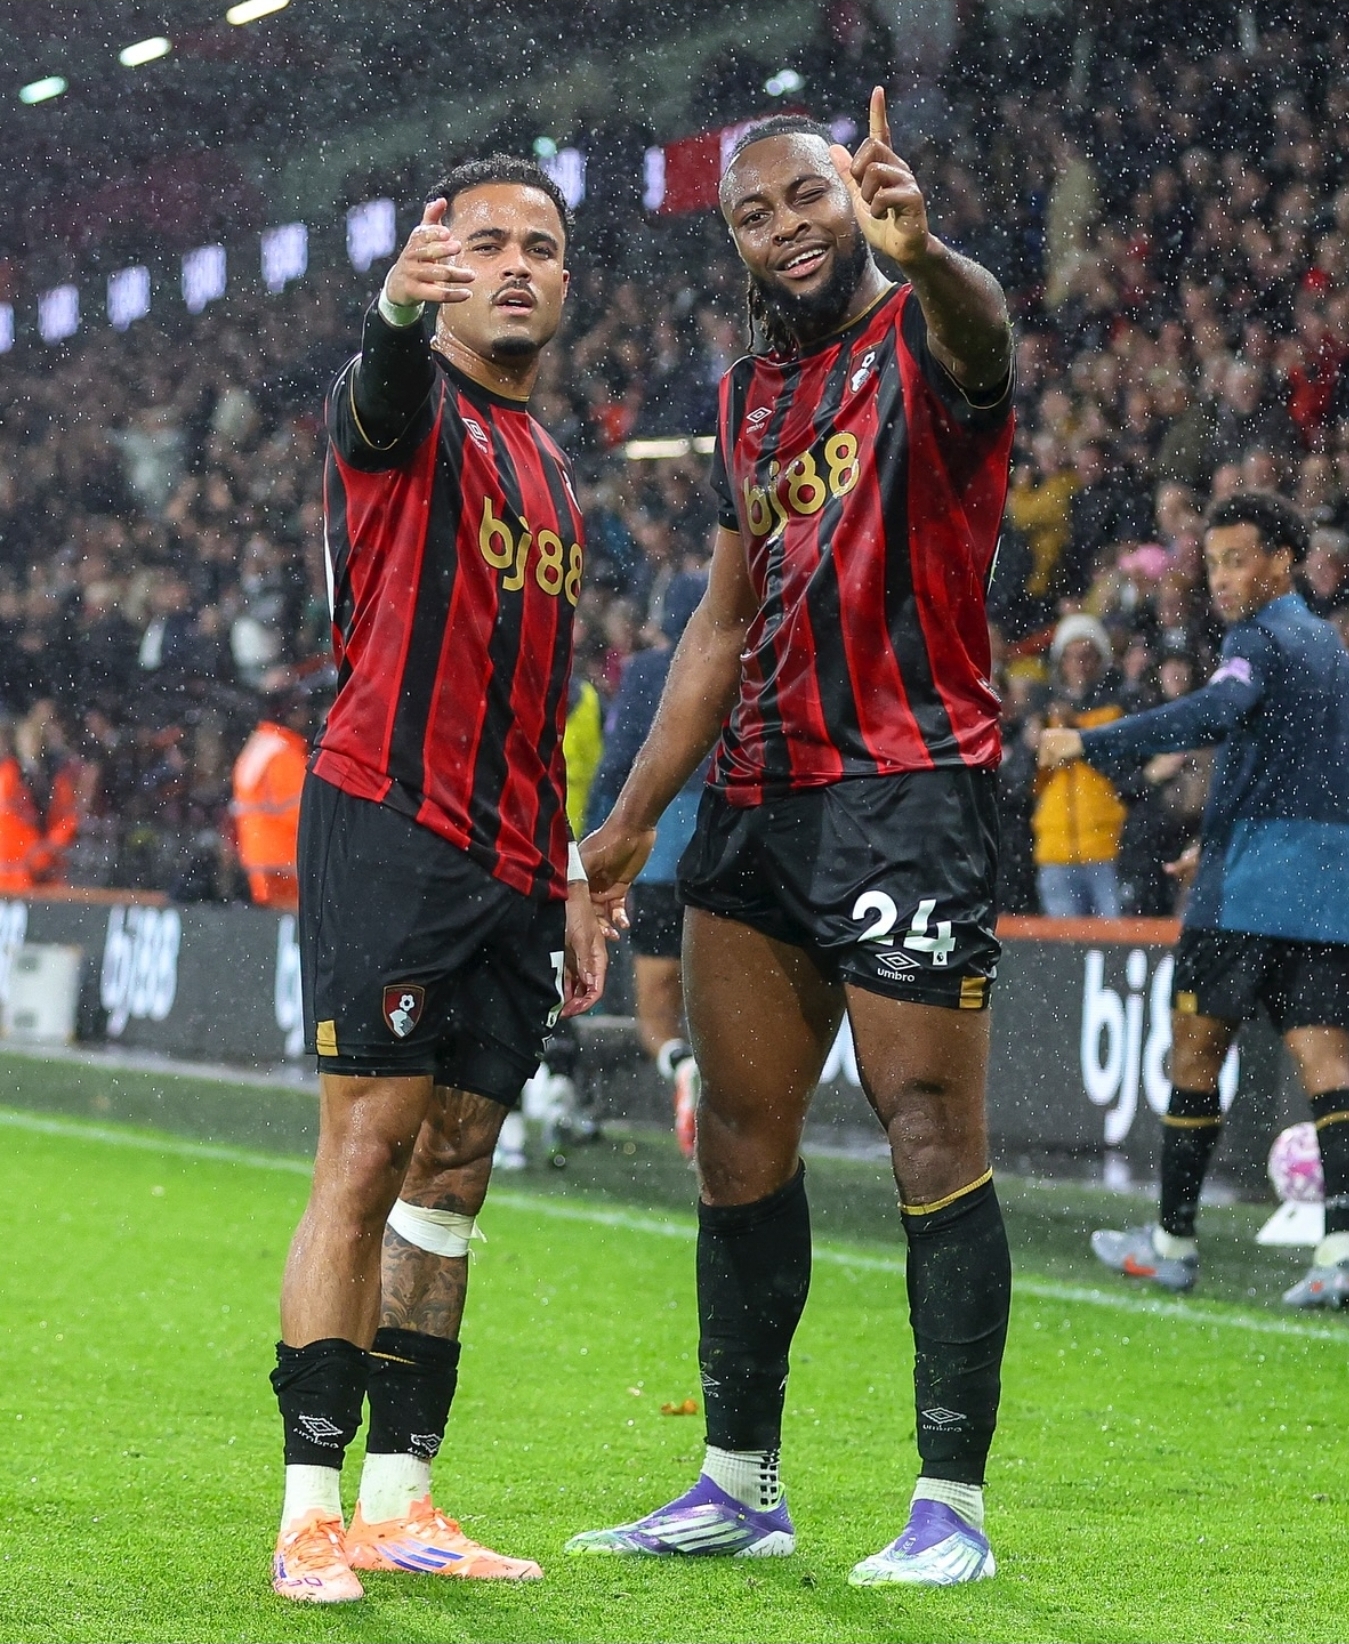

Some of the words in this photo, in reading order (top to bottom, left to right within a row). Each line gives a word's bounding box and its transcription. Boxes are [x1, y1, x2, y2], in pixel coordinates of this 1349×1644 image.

[743, 432, 860, 545] bj88
[479, 495, 583, 608] bj88
[852, 890, 957, 966] 24
[877, 967, 915, 983] umbro
[923, 1423, 962, 1433] umbro
